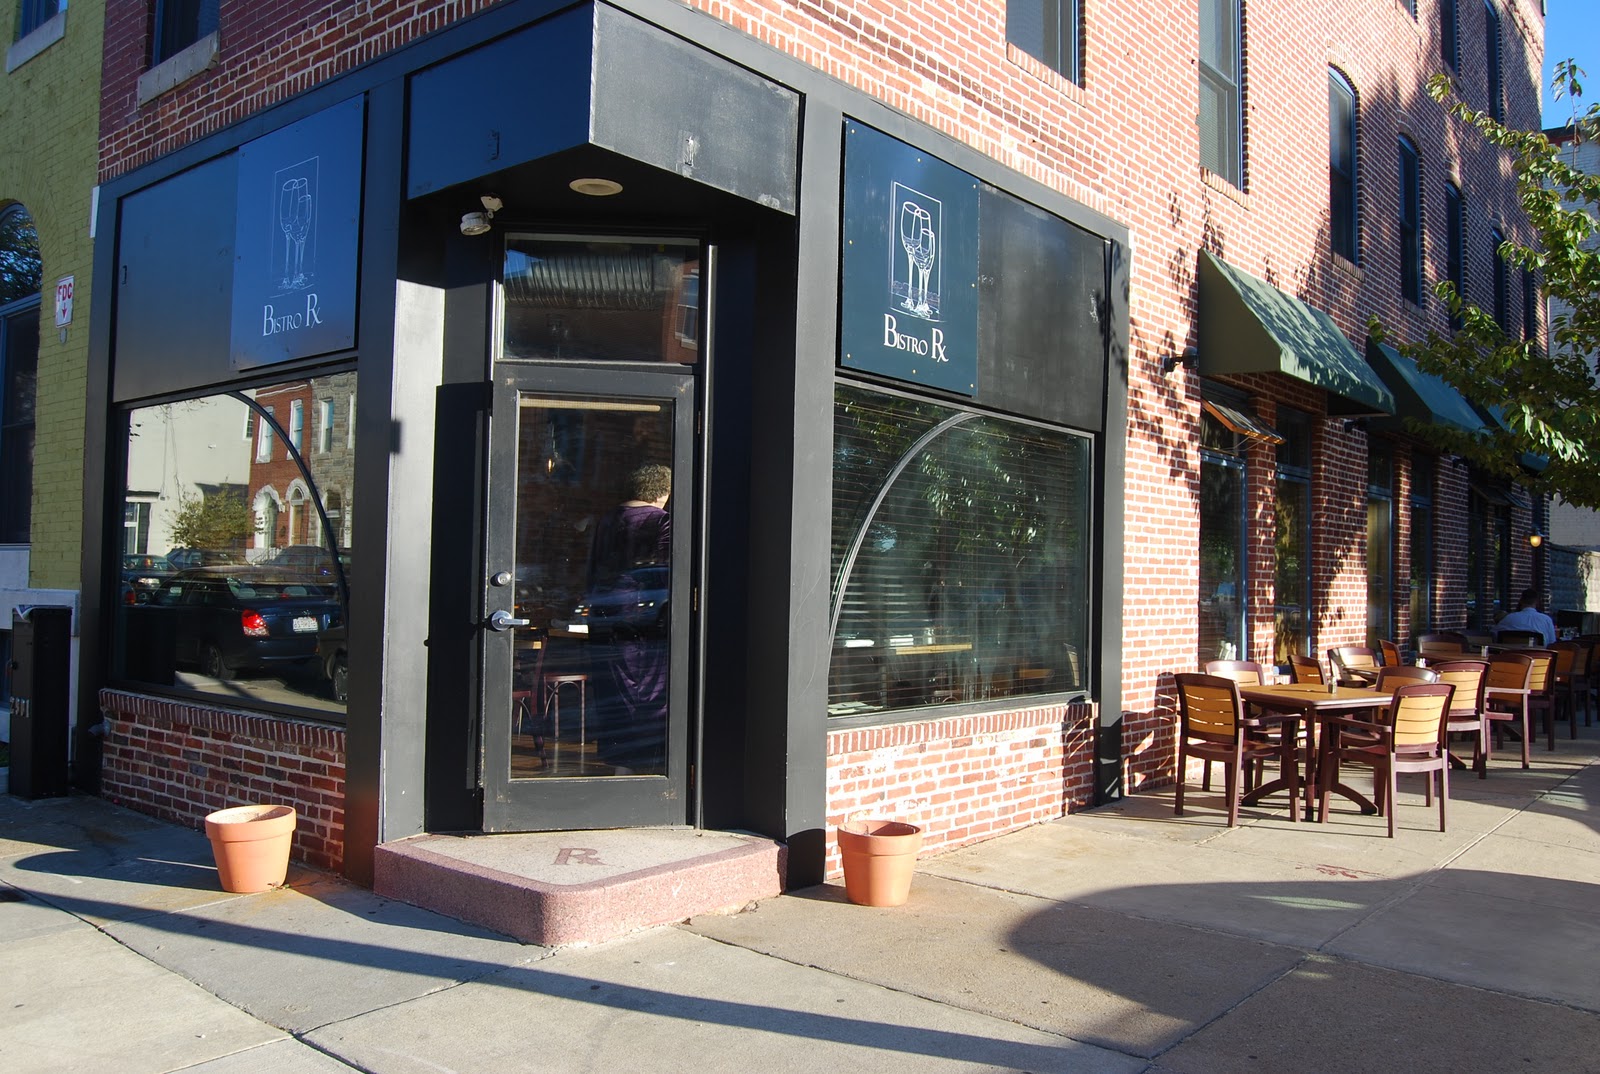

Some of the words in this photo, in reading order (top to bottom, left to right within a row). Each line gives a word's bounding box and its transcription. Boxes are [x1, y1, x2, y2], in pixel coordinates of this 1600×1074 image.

[57, 283, 73, 302] FDC
[263, 304, 302, 336] BISTRO
[884, 314, 928, 355] BISTRO
